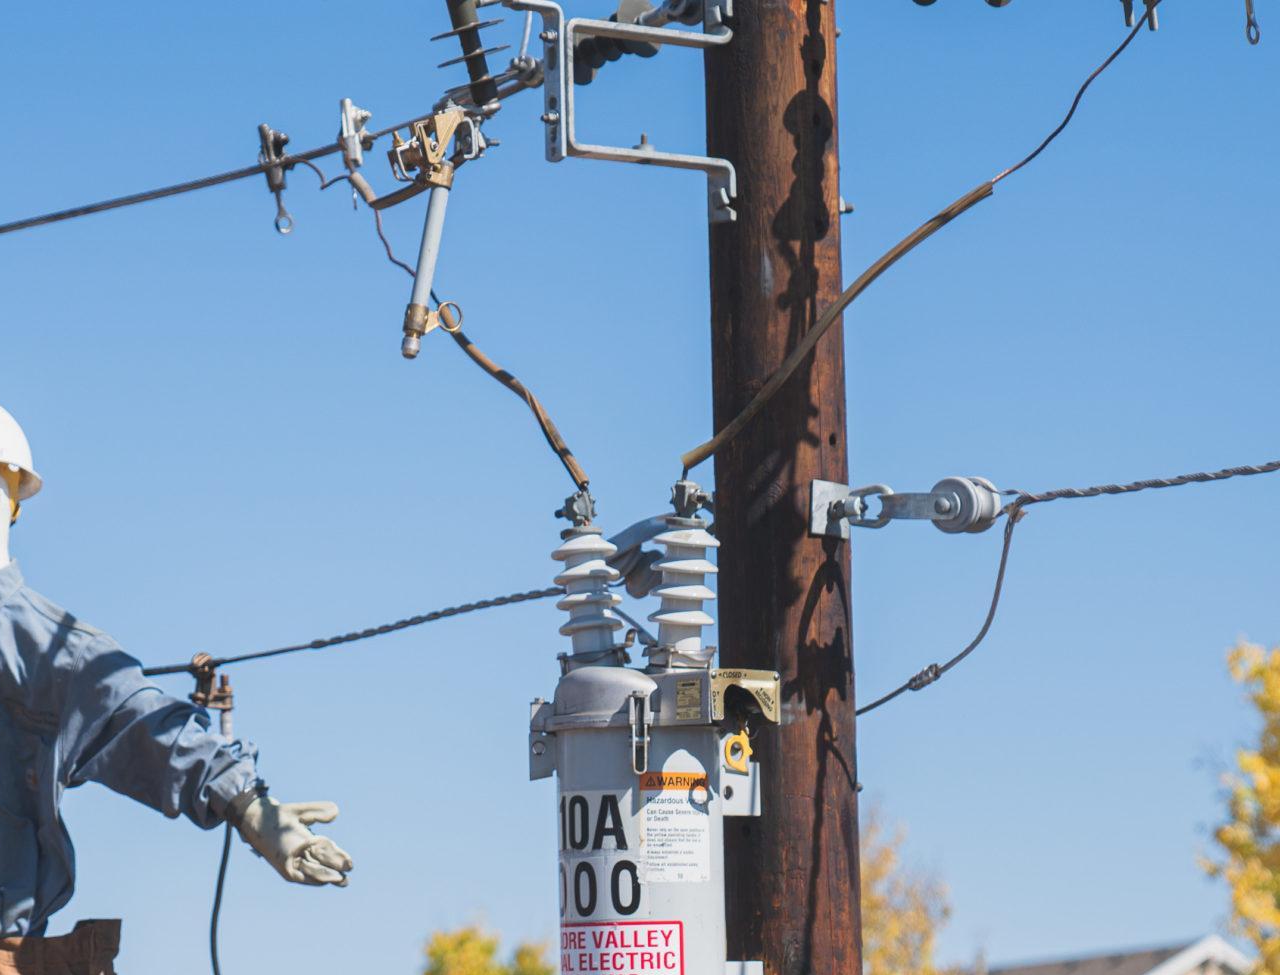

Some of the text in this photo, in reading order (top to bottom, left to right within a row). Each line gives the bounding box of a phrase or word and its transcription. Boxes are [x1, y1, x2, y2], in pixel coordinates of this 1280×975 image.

[723, 671, 742, 679] CLOSED
[656, 776, 706, 787] WARNING
[646, 796, 684, 804] Hazardous
[591, 929, 674, 949] VALLEY
[579, 951, 676, 972] ELECTRIC
